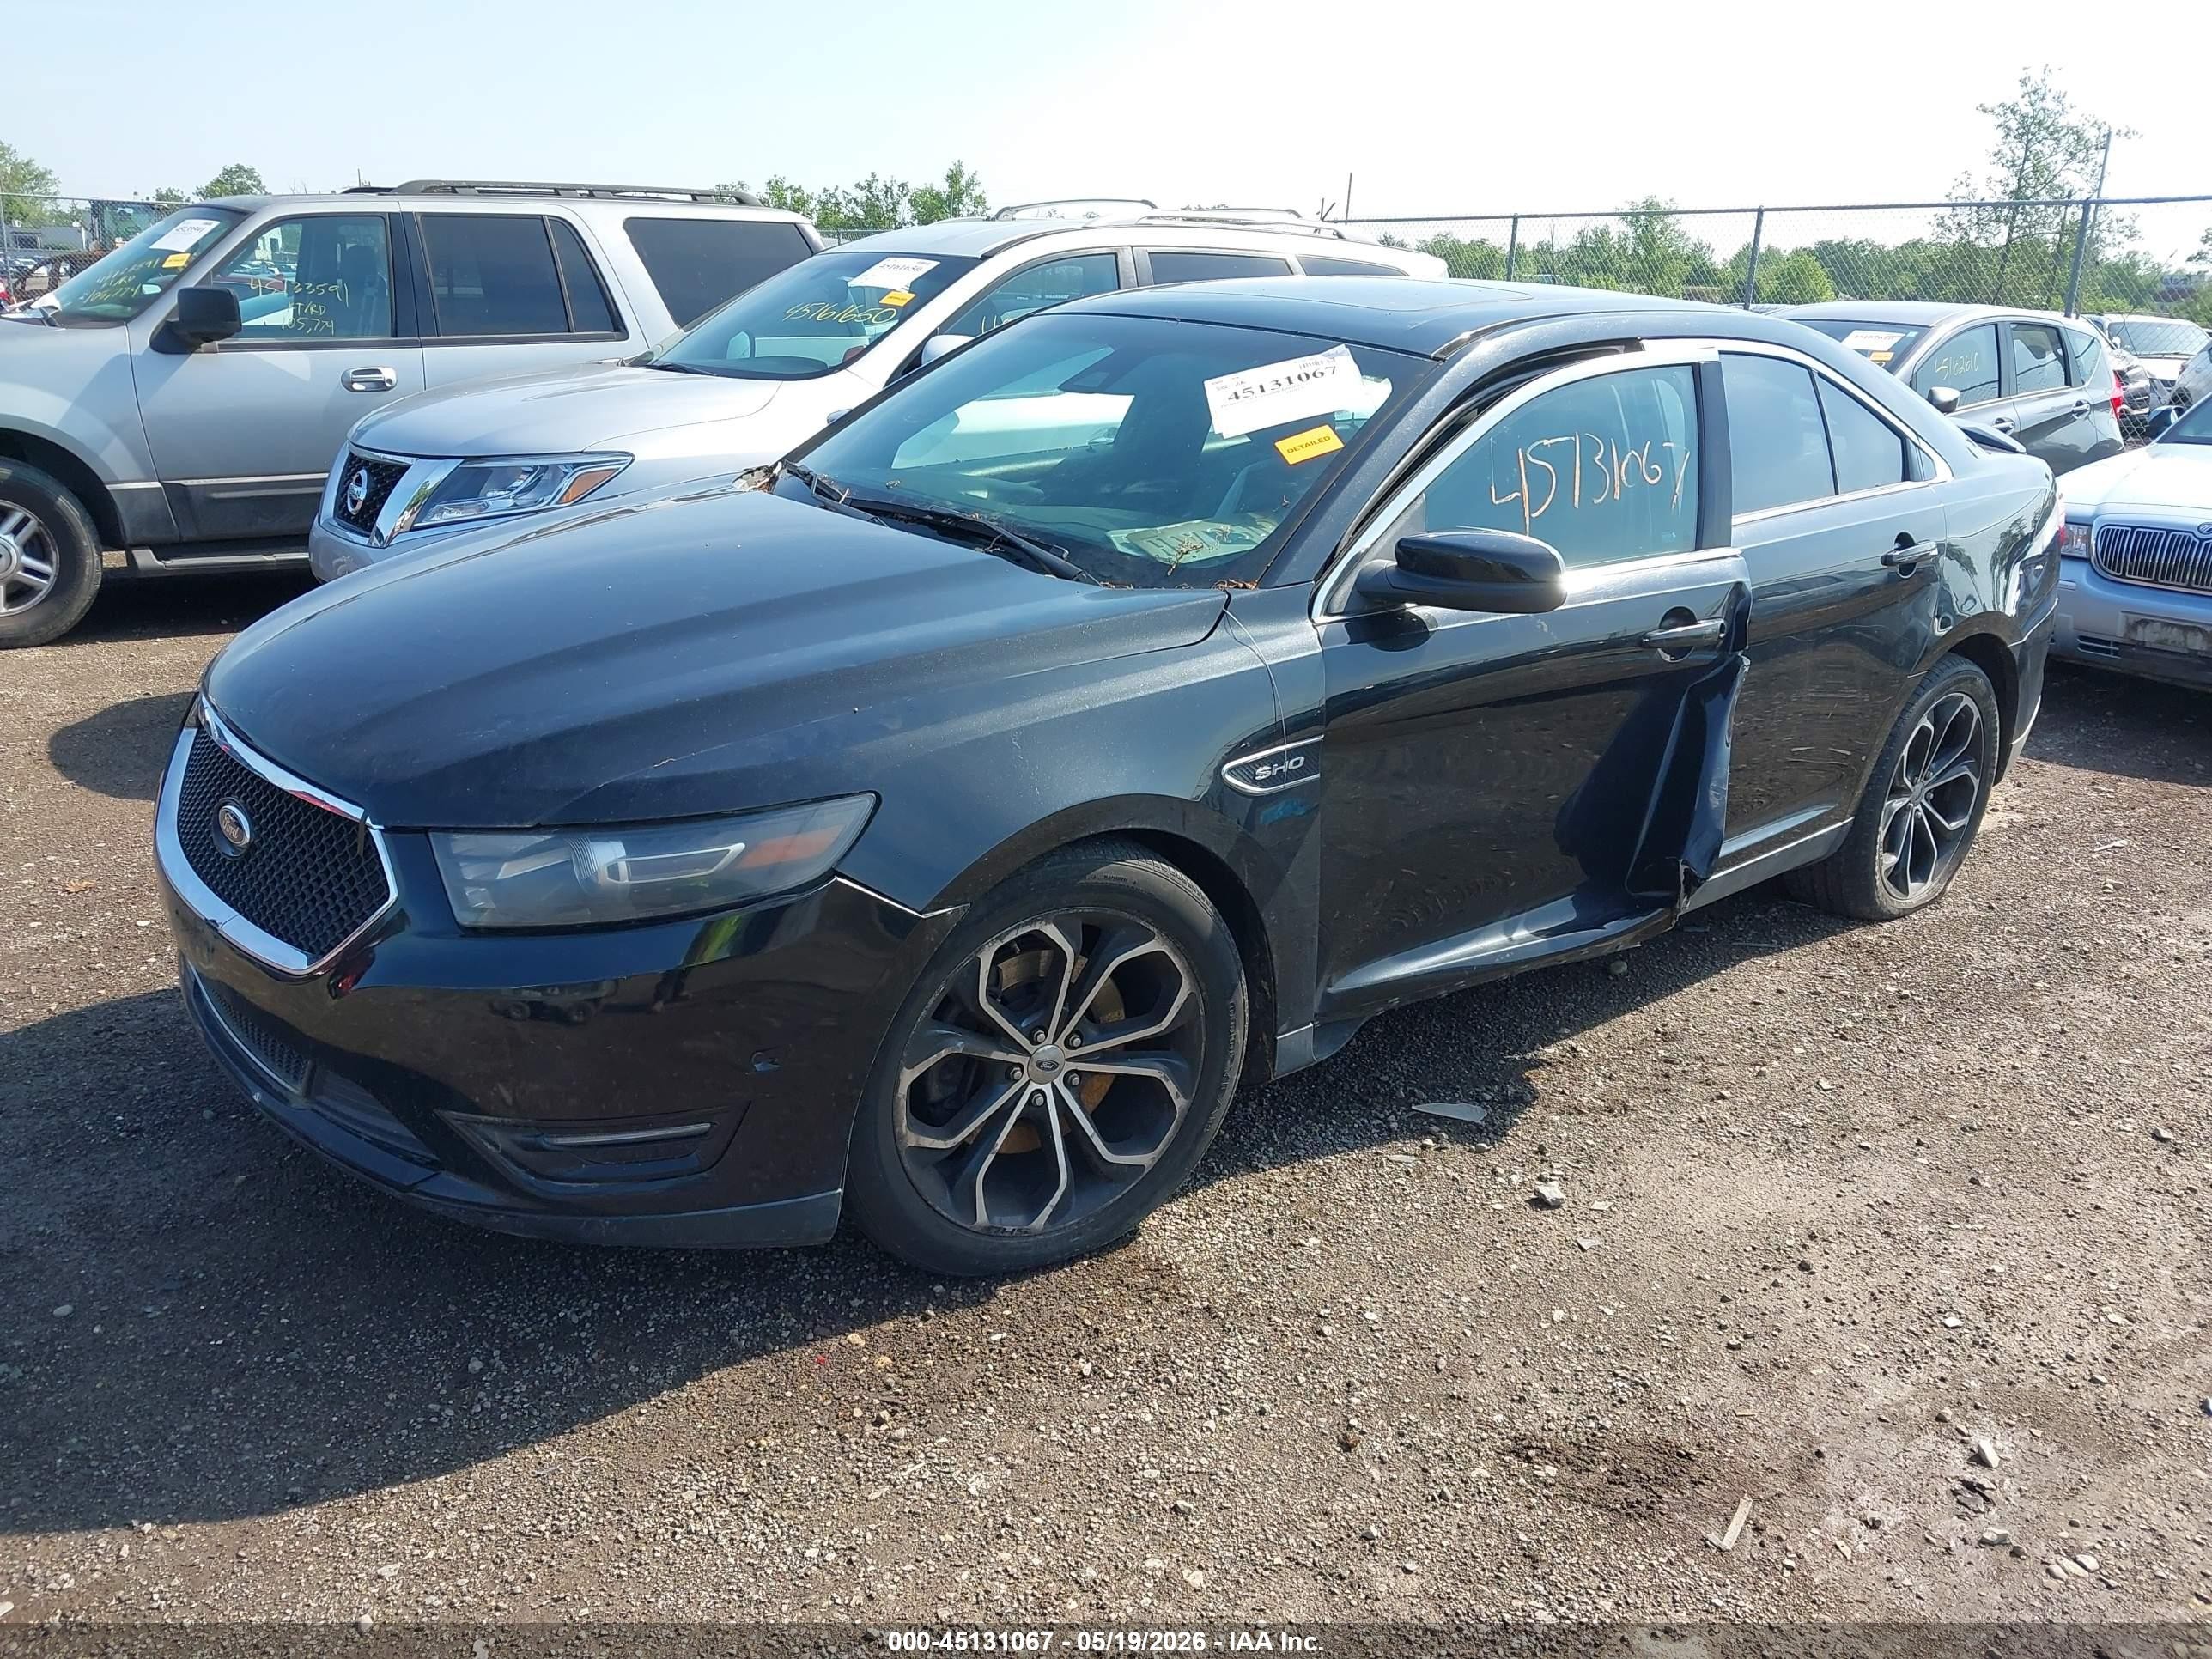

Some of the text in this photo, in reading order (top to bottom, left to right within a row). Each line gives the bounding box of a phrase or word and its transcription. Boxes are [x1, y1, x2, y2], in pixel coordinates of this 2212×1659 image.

[250, 276, 349, 307] 45133591
[781, 301, 897, 325] 45161650
[1227, 365, 1337, 401] 45131067
[1285, 434, 1332, 454] DETAILED
[1254, 756, 1304, 781] SHO
[222, 812, 240, 839] Ford
